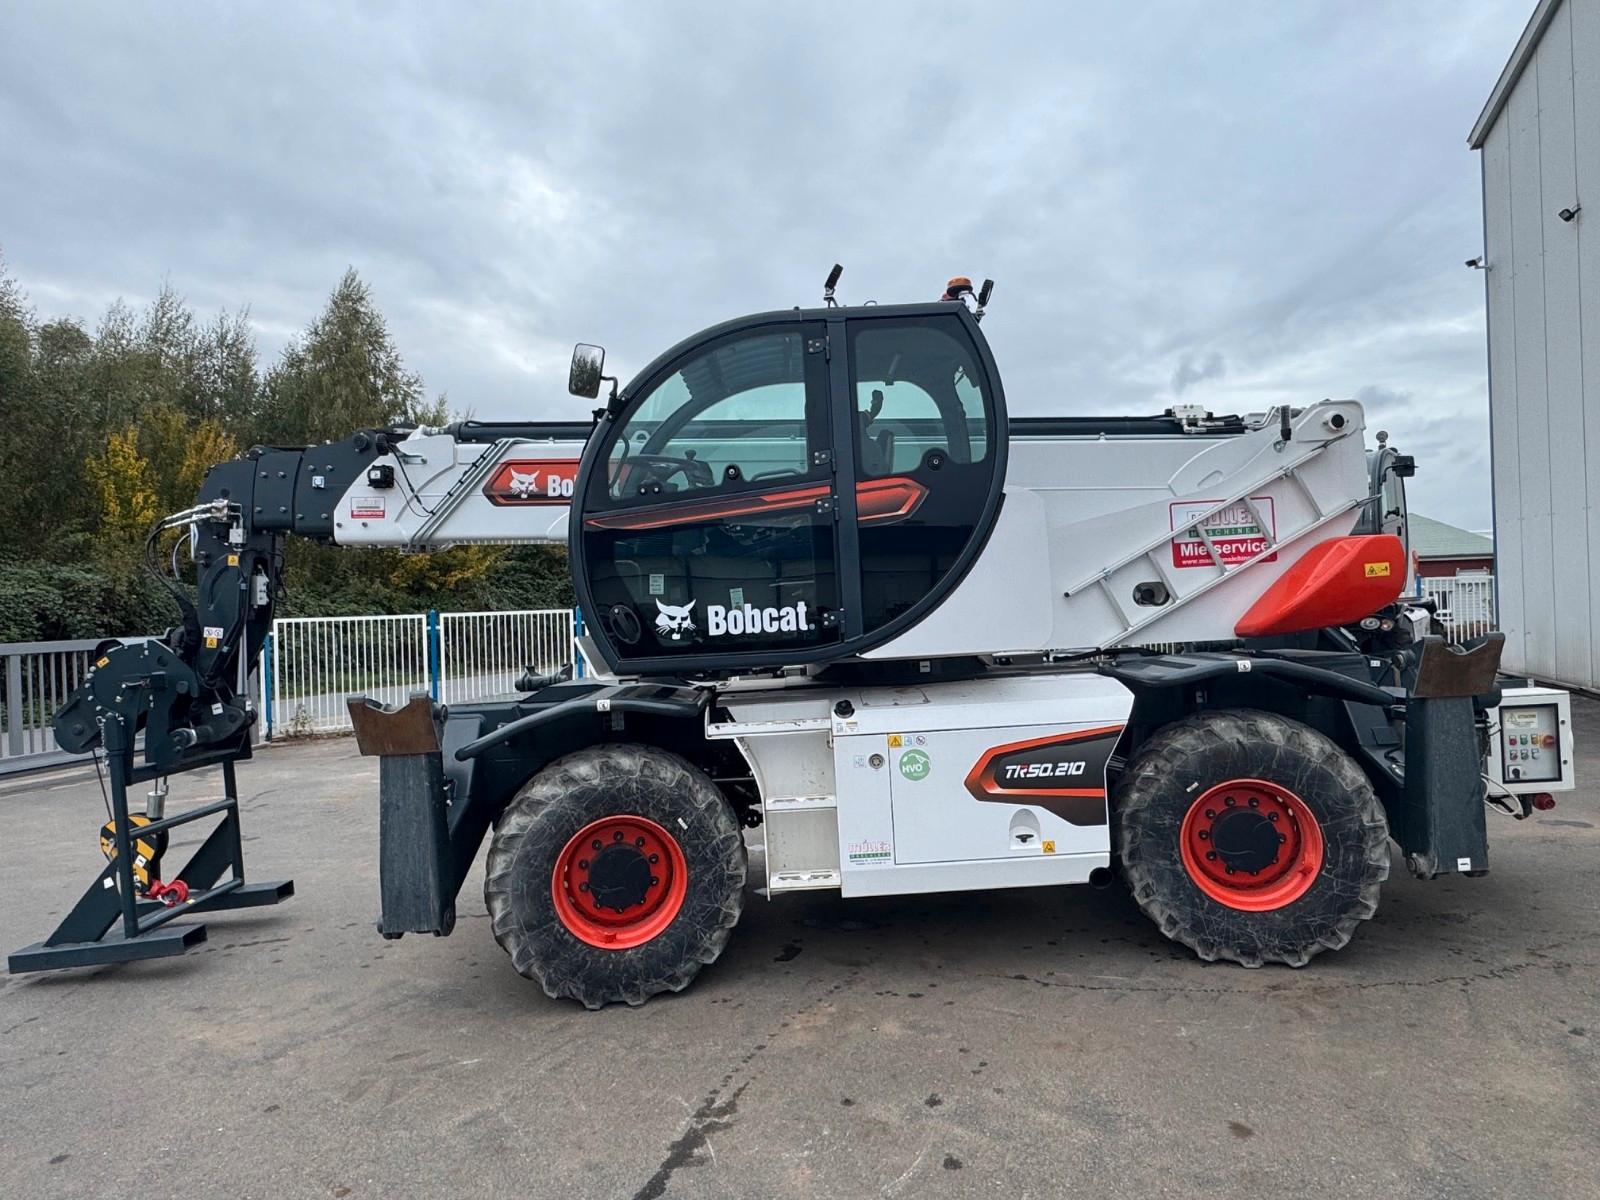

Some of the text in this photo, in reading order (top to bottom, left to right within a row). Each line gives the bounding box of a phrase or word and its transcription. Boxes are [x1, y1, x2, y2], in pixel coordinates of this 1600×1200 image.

[547, 474, 576, 497] Bo
[1190, 527, 1259, 537] MSCHINEN
[1180, 539, 1269, 557] Mieservice
[707, 601, 808, 636] Bobcat
[902, 763, 923, 773] HVO
[1005, 761, 1086, 779] TR50.210
